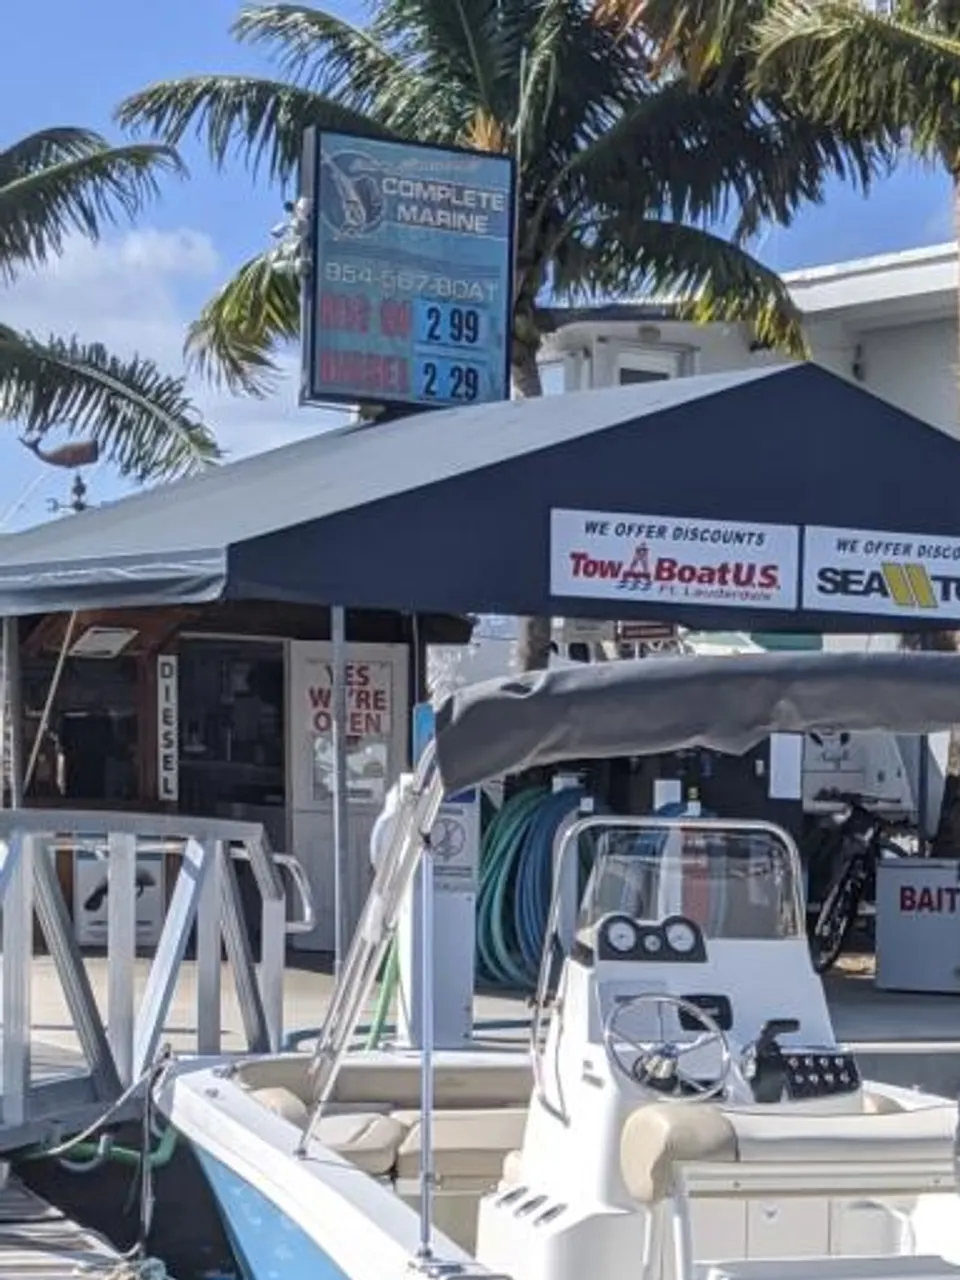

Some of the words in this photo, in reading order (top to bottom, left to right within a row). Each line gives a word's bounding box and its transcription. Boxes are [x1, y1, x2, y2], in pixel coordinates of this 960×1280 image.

[382, 178, 505, 212] COMPLETE
[397, 204, 489, 233] MARINE
[426, 306, 442, 341] 2
[449, 307, 480, 344] 99
[423, 362, 437, 396] 2
[449, 365, 480, 400] 29
[584, 520, 610, 536] WE
[615, 522, 669, 539] OFFER
[672, 525, 766, 547] DISCOUNTS
[837, 538, 859, 554] WE
[864, 540, 913, 557] OFFER
[569, 551, 624, 579] Tow
[816, 567, 890, 598] SEA
[308, 686, 387, 711] W'RE
[160, 662, 175, 796] DIESEL
[314, 710, 381, 733] OEN
[899, 885, 960, 913] BAIT
